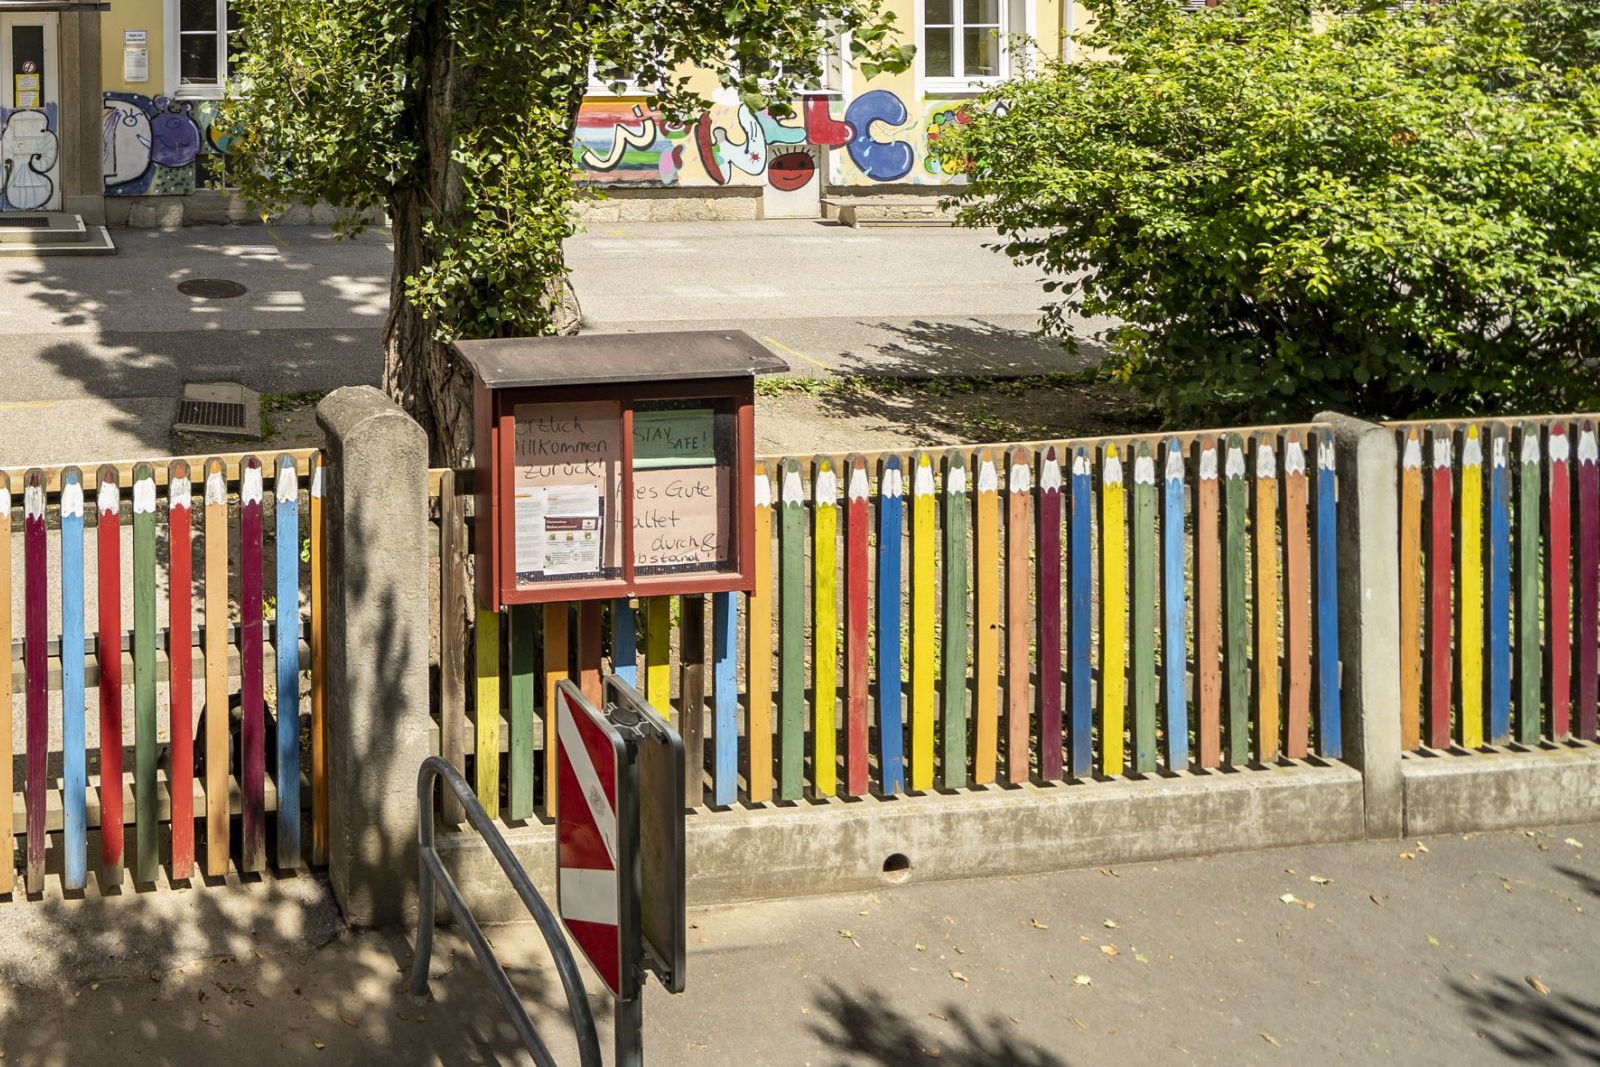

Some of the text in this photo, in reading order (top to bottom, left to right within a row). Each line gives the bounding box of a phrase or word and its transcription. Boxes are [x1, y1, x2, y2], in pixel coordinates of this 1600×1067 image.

[515, 415, 584, 435] erzlich
[633, 427, 671, 443] STAY
[515, 440, 607, 455] illkommen
[665, 480, 713, 499] Gute
[652, 535, 698, 551] durch
